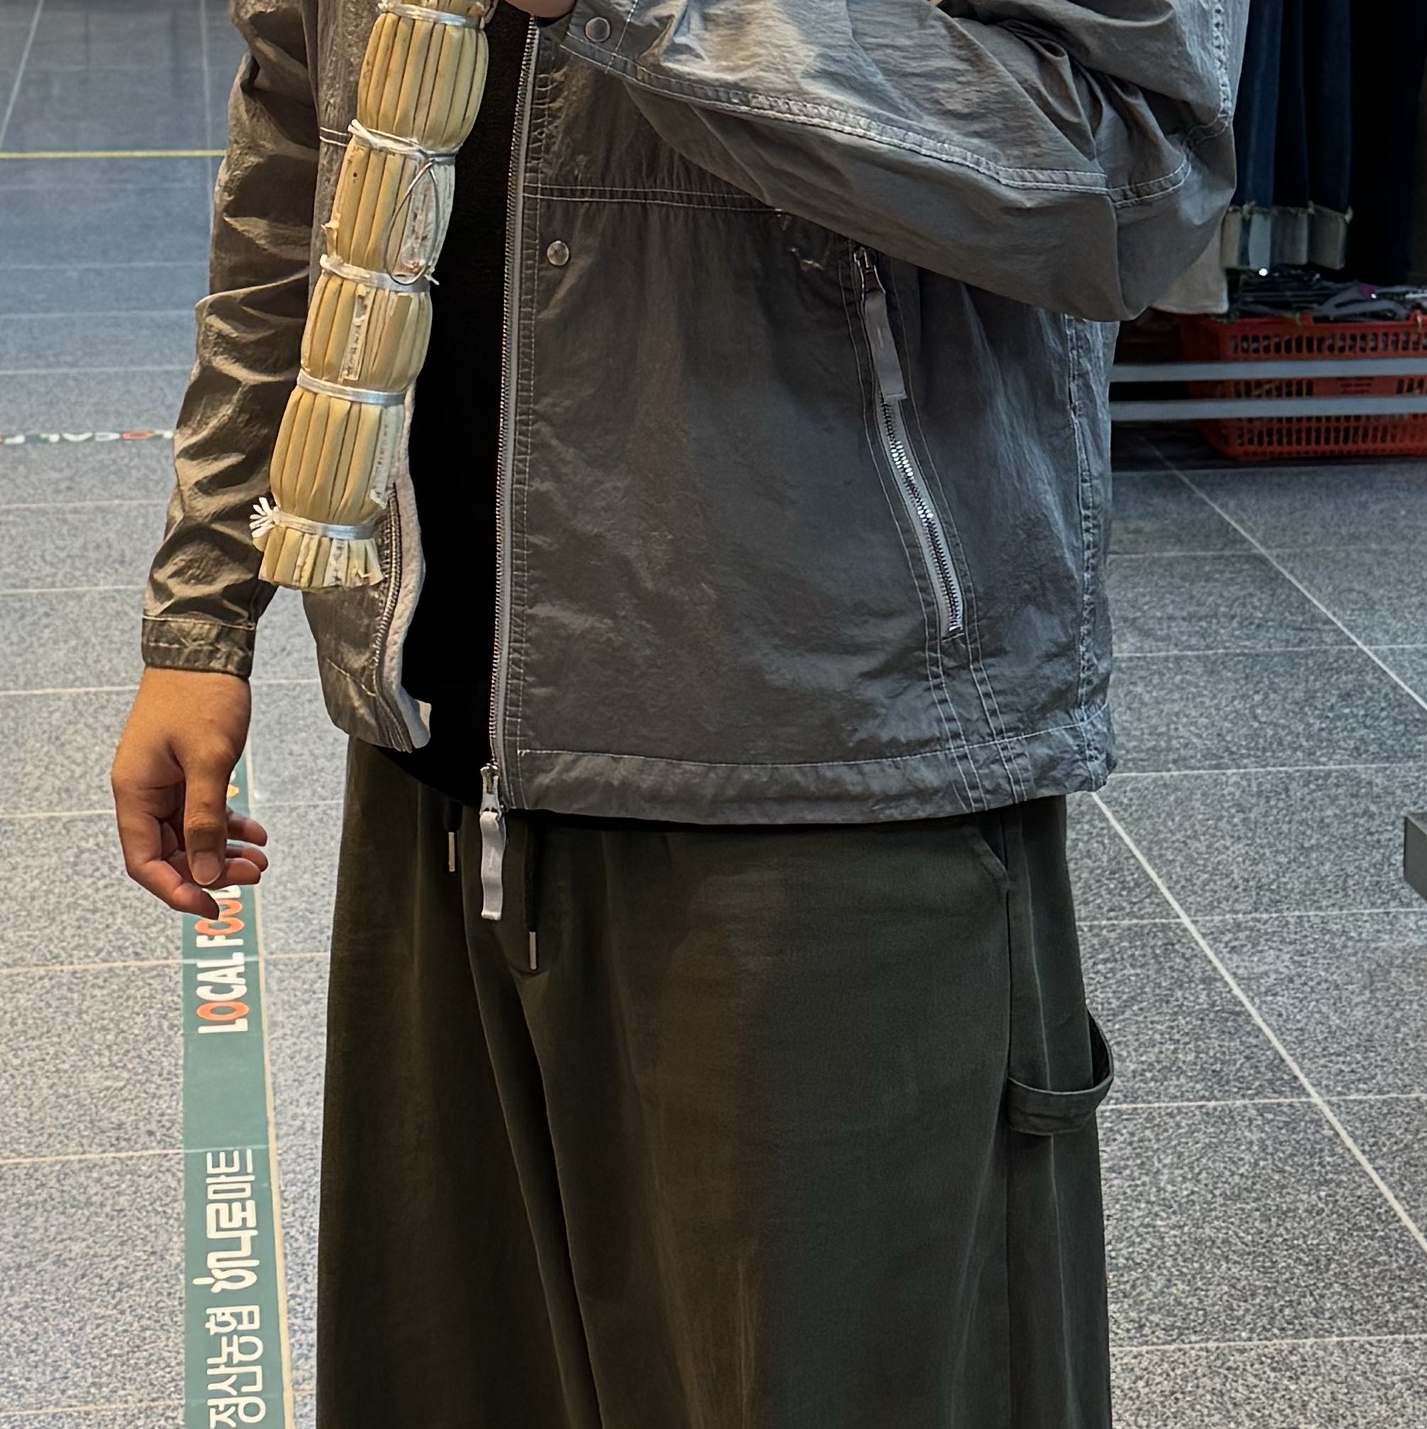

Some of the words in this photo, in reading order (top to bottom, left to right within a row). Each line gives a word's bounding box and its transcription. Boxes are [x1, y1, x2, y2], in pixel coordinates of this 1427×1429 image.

[196, 952, 248, 1034] LOCAL
[192, 1149, 260, 1294] 하나로마트
[205, 1304, 266, 1429] 정산농협
